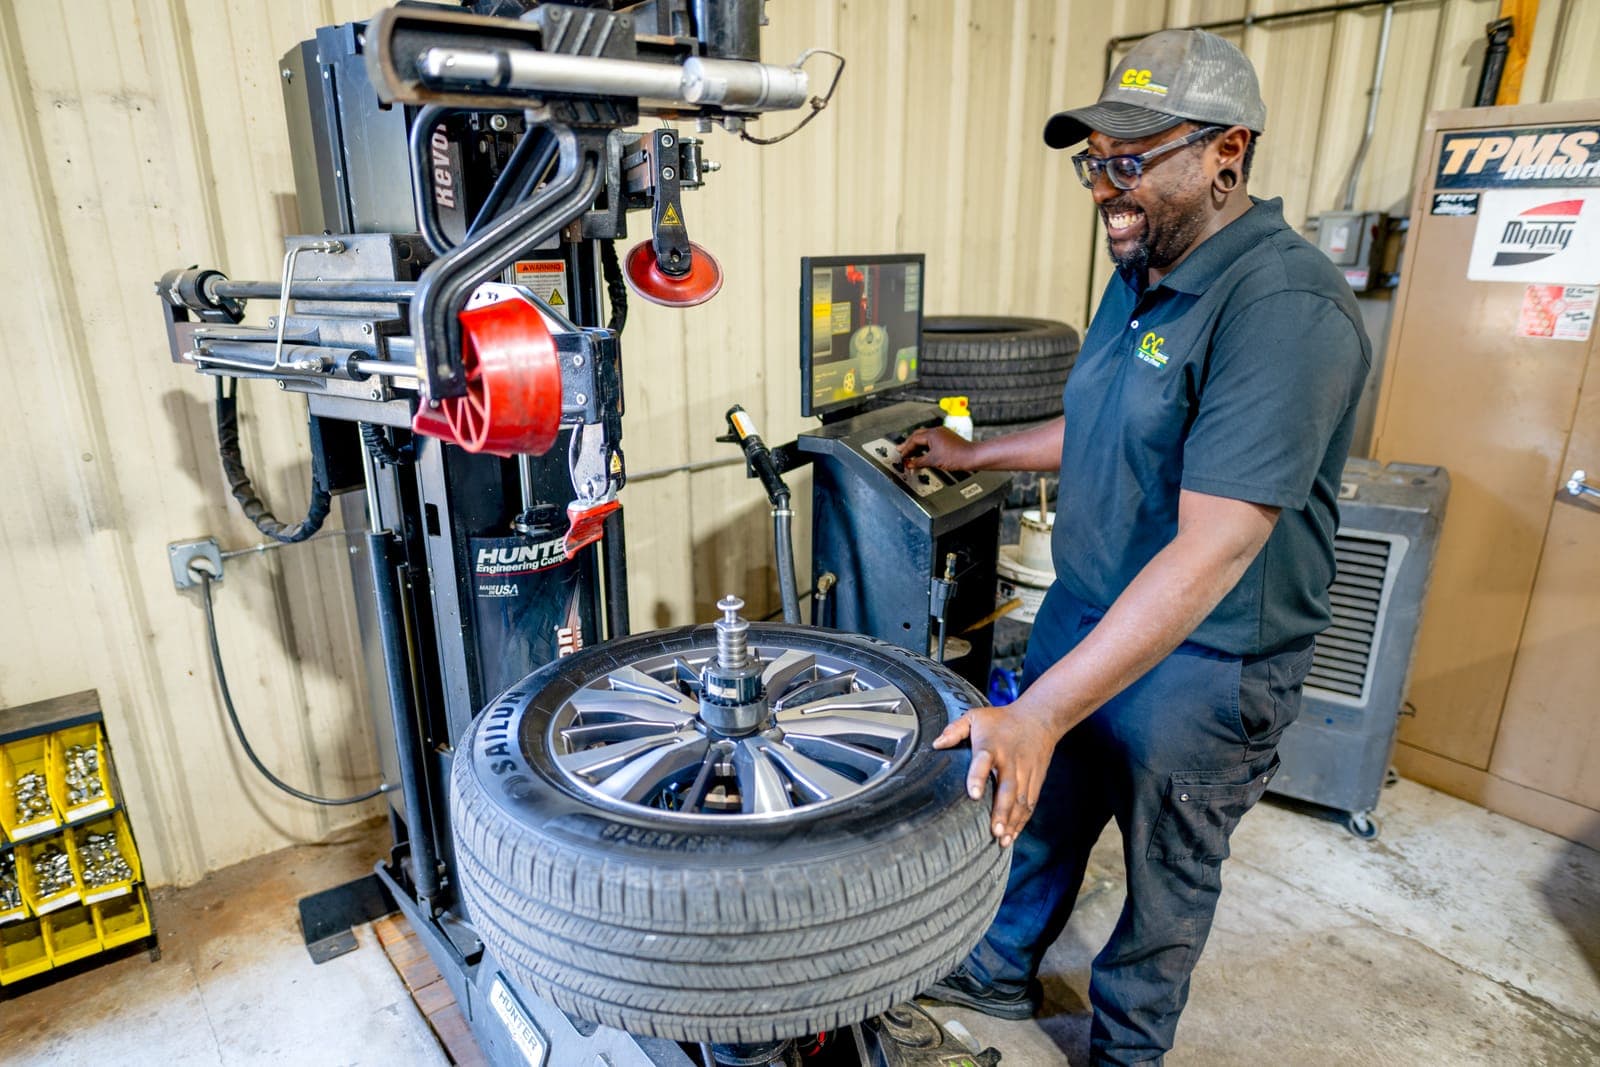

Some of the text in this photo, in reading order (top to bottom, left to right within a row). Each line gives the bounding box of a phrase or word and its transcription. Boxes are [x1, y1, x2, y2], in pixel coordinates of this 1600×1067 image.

[1121, 68, 1152, 85] CC
[432, 123, 455, 208] Revo
[1441, 131, 1599, 175] TPMS
[528, 263, 561, 271] WARNING
[476, 552, 567, 574] Engineering Comp
[477, 537, 565, 565] HUNTE
[495, 583, 519, 595] USA
[484, 691, 528, 775] SAILUN
[498, 990, 538, 1051] HUNTER
